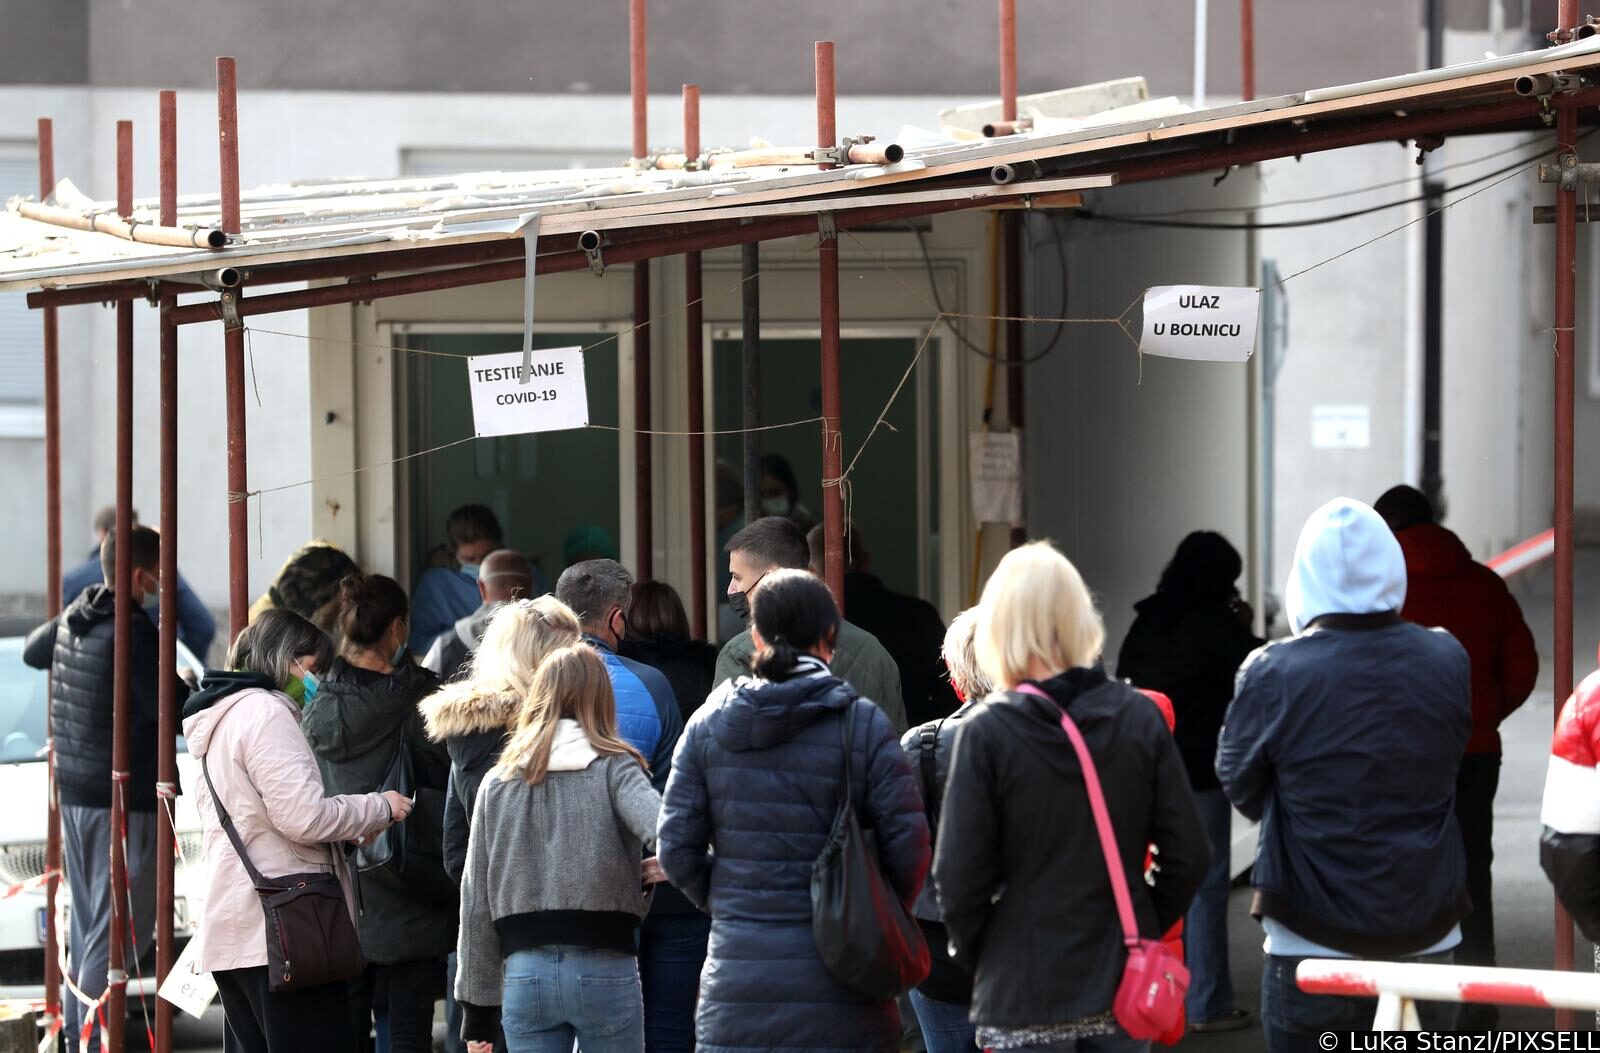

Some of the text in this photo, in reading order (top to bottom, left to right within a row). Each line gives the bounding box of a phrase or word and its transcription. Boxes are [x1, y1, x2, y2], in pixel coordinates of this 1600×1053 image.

[1179, 295, 1220, 309] ULAZ
[1153, 323, 1241, 337] U BOLNICU
[496, 390, 557, 406] COVID-19
